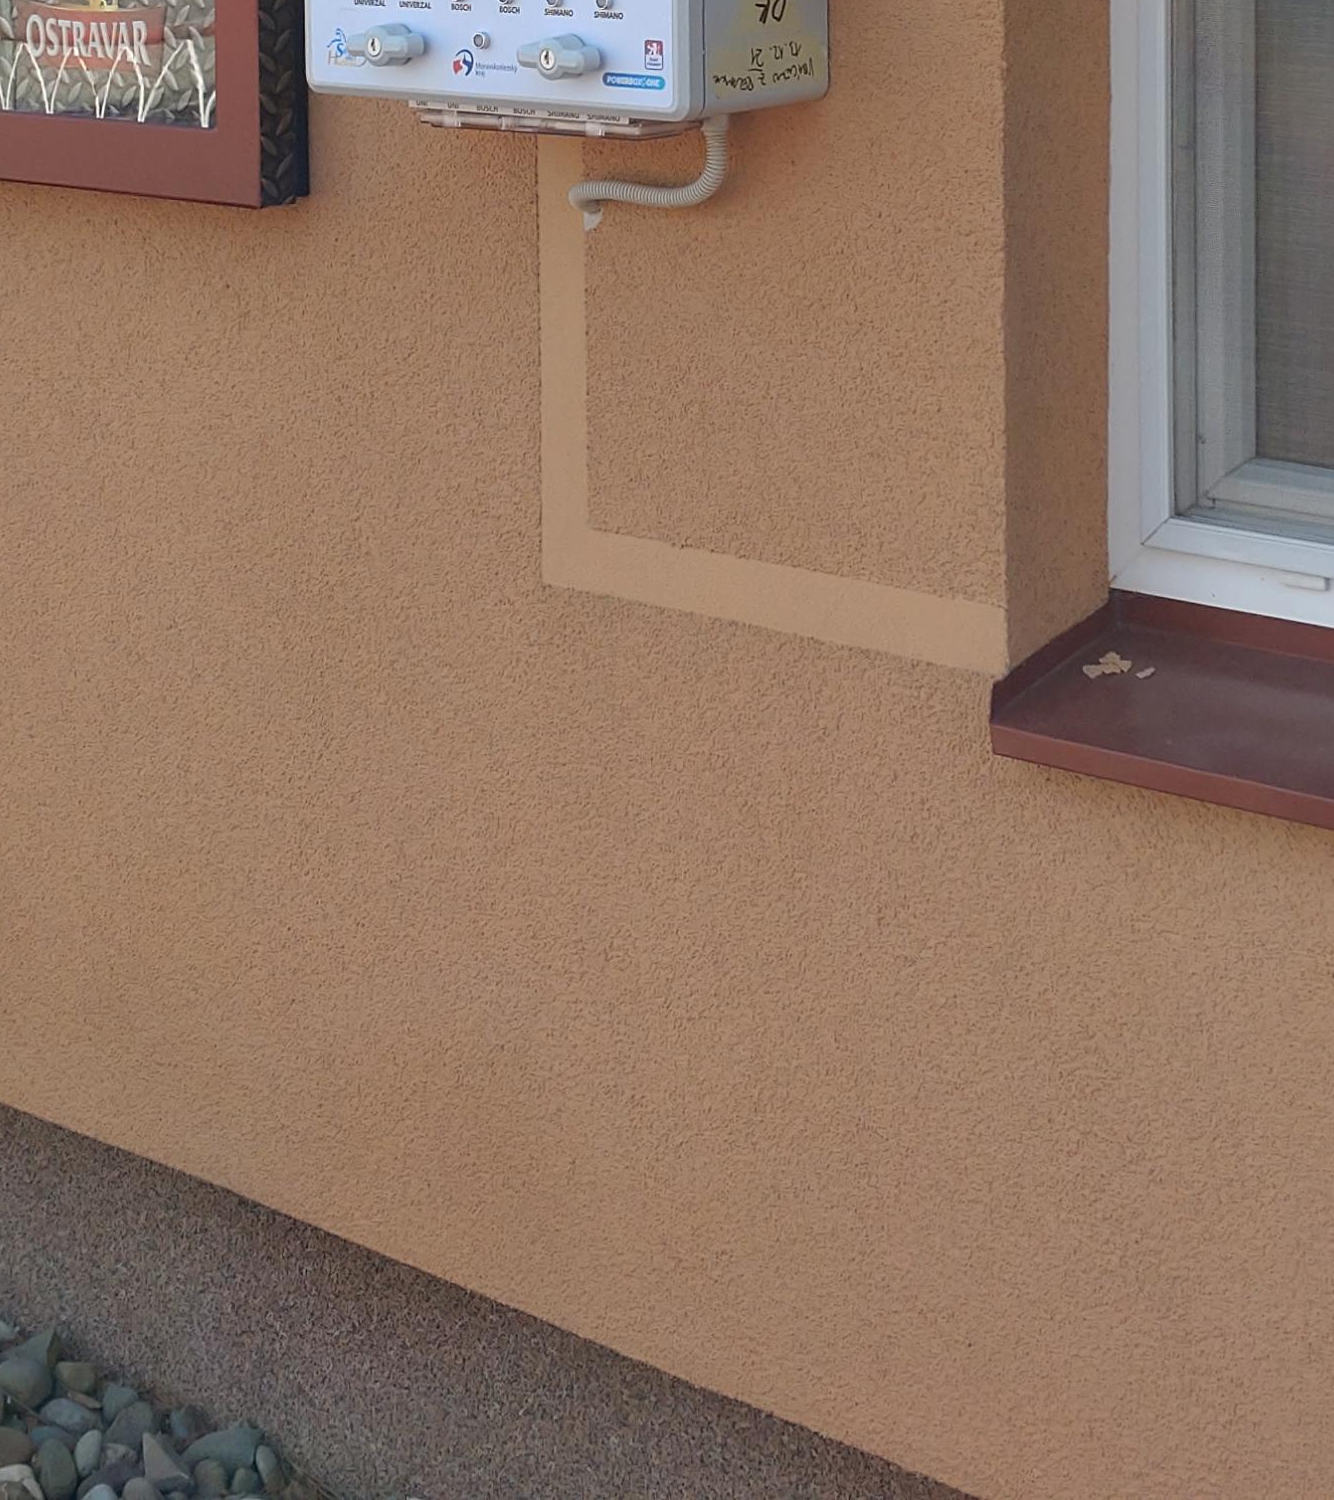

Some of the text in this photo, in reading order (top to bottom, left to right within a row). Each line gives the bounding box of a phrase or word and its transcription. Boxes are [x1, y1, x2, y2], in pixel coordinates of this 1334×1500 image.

[354, 0, 385, 7] UNIVERZAL
[399, 1, 432, 9] UNIVERZAL
[451, 3, 472, 11] BOSCH
[499, 6, 520, 14] BOSCH
[544, 8, 574, 17] SHIMANO
[594, 11, 624, 20] SHIMANO
[26, 14, 152, 66] OSTRAVAR
